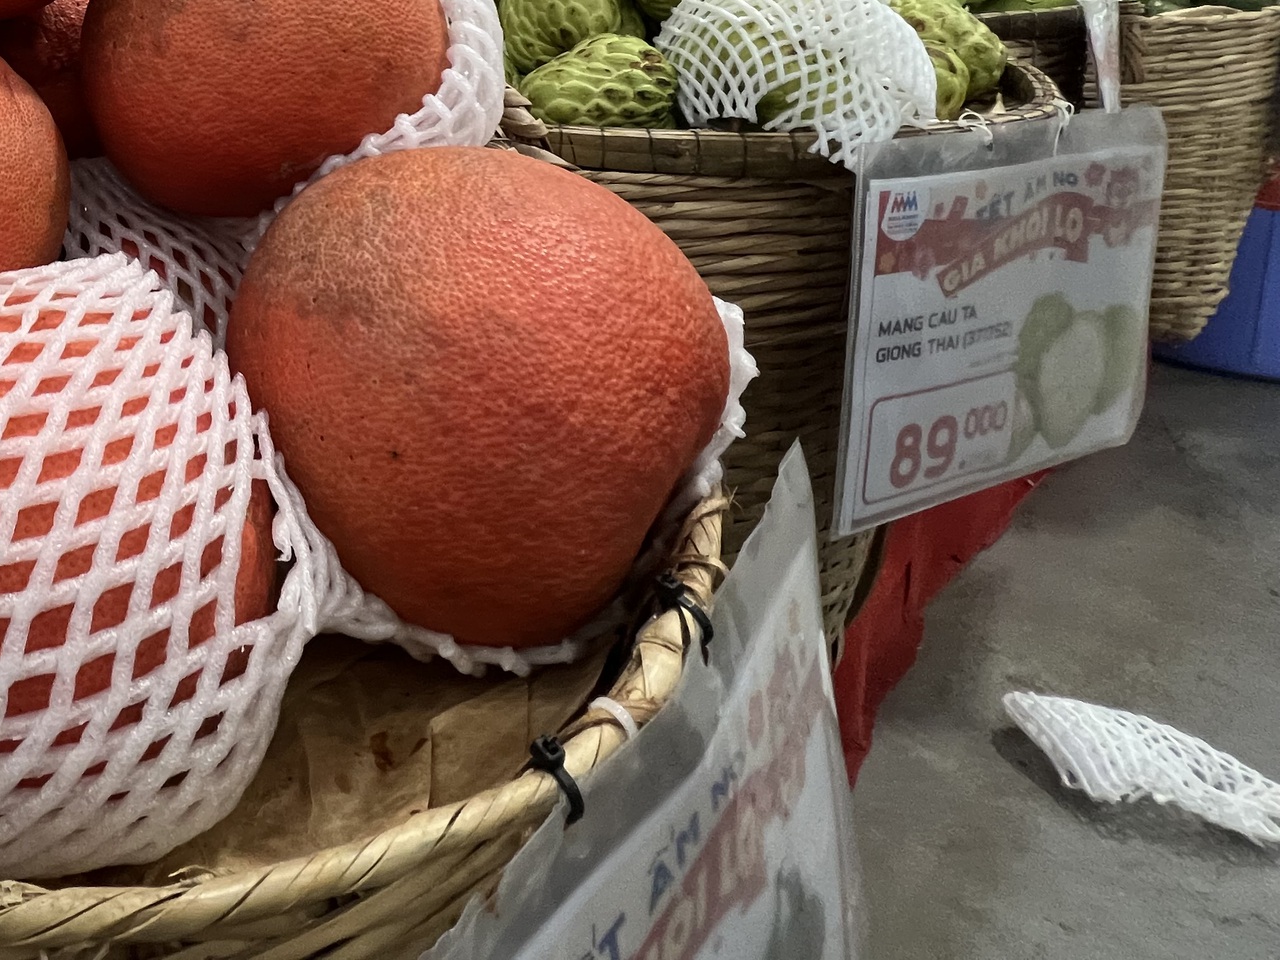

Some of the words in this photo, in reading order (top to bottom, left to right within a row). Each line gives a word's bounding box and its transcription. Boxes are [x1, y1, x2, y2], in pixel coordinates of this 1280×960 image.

[1054, 204, 1084, 243] LO
[878, 316, 923, 338] MANG
[928, 308, 958, 328] CAU
[962, 304, 978, 320] TA
[876, 342, 922, 363] GIONG
[928, 334, 960, 355] THAI
